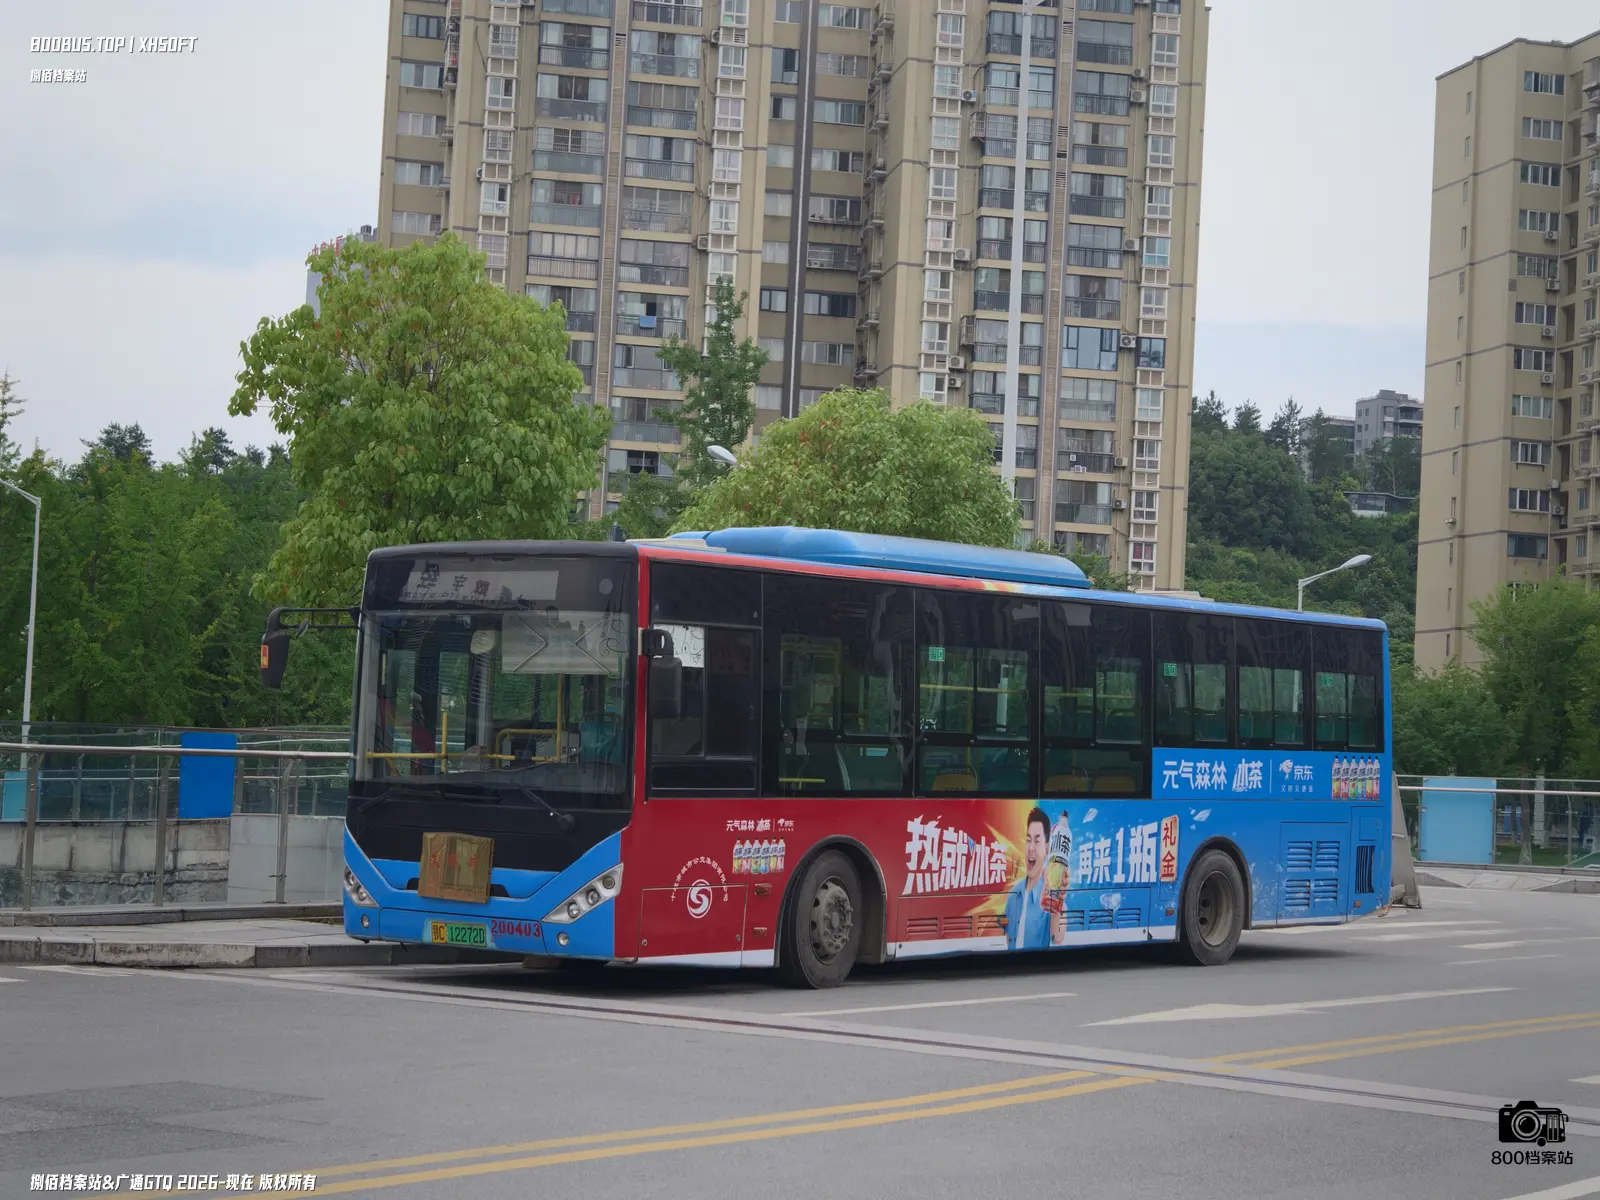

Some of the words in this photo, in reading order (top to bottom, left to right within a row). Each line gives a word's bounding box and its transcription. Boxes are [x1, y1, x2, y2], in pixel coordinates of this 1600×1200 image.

[1162, 759, 1227, 790] 元气森林
[1232, 758, 1263, 792] 冰茶
[1294, 765, 1313, 781] 京东
[902, 814, 1007, 895] 热就冰茶
[1080, 822, 1158, 884] 再来1瓶
[1161, 821, 1176, 878] 礼金
[491, 919, 541, 937] 200403
